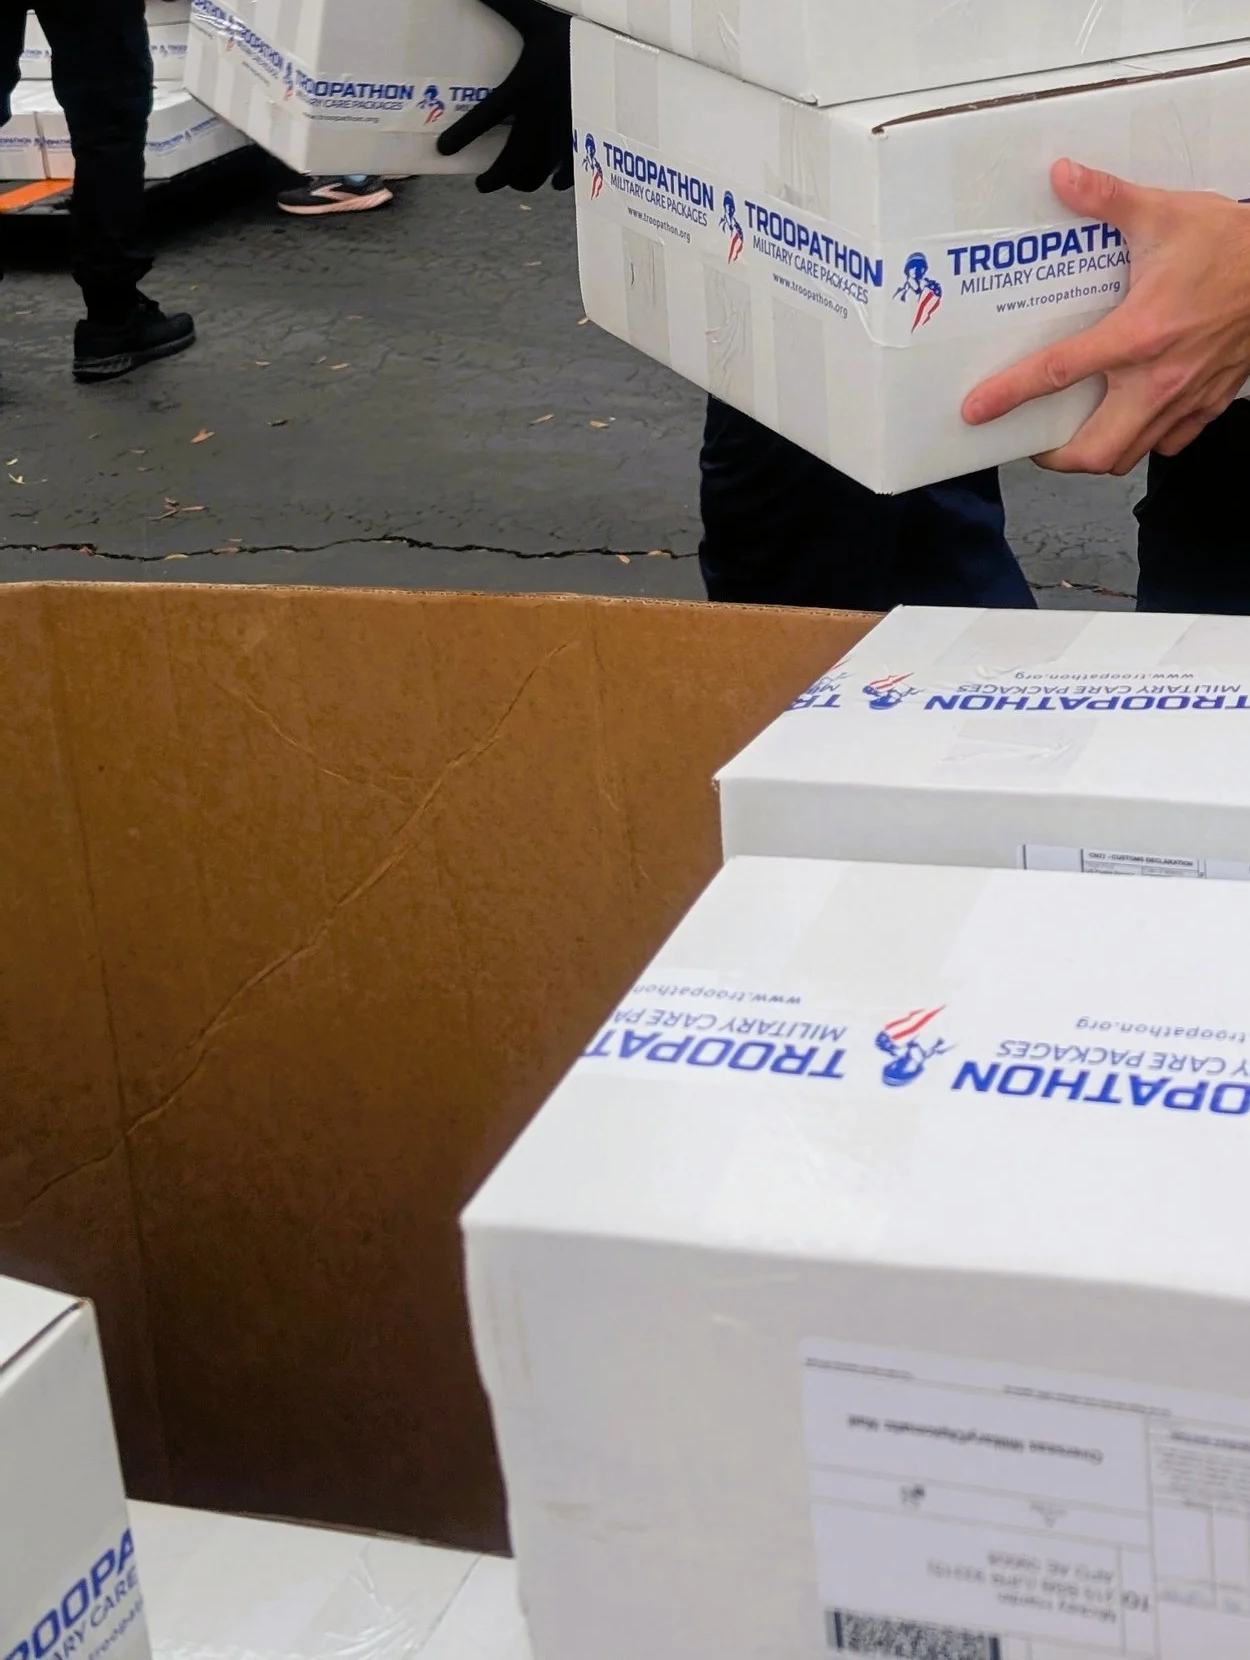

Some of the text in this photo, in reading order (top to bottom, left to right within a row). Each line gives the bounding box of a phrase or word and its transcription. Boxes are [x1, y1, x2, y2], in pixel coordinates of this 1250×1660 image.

[603, 141, 714, 212] TROOPATHON
[610, 173, 708, 228] MILITARY CARE PACKAGES
[627, 206, 691, 244] www.troopathon.org
[744, 200, 883, 288] TROOPATHON
[947, 222, 1128, 277] TROOPATH
[752, 235, 869, 306] MILITARY CARE PACKAGES
[960, 267, 1034, 296] MILITARY
[1035, 260, 1076, 282] CARE
[772, 272, 849, 320] www.troopathon.org
[996, 281, 1121, 313] www.troopathon.org
[956, 683, 1241, 695] MILITARY CARE PACKAGES
[1014, 669, 1195, 681] www.troopathon.org
[647, 1009, 717, 1029] CARE
[719, 1014, 847, 1042] MILITARY
[997, 1040, 1143, 1069] PACKAGES
[1151, 1053, 1227, 1075] CARE
